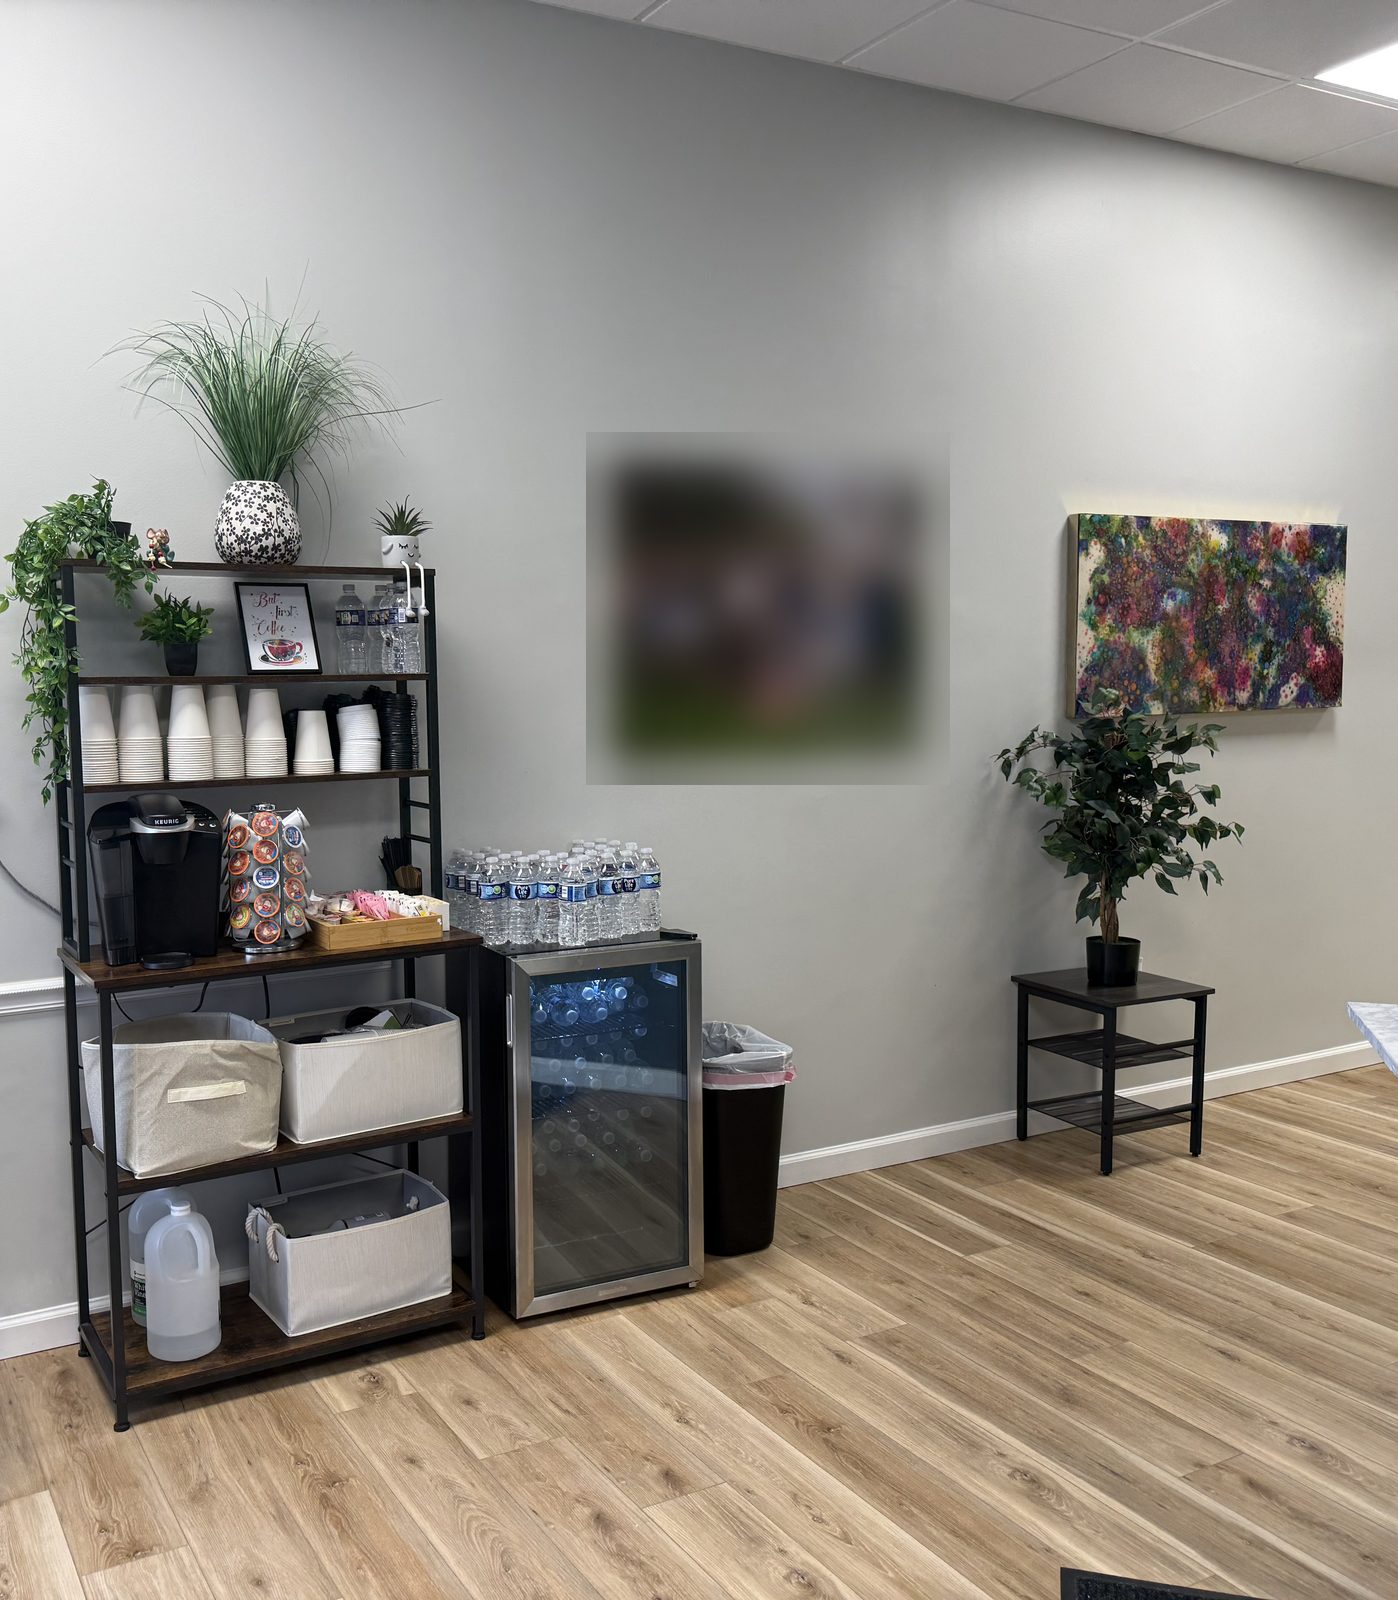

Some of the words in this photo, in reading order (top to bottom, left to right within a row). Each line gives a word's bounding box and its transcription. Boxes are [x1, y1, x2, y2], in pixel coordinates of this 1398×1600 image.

[253, 592, 281, 608] But
[275, 605, 297, 620] first
[253, 619, 286, 636] Coffee
